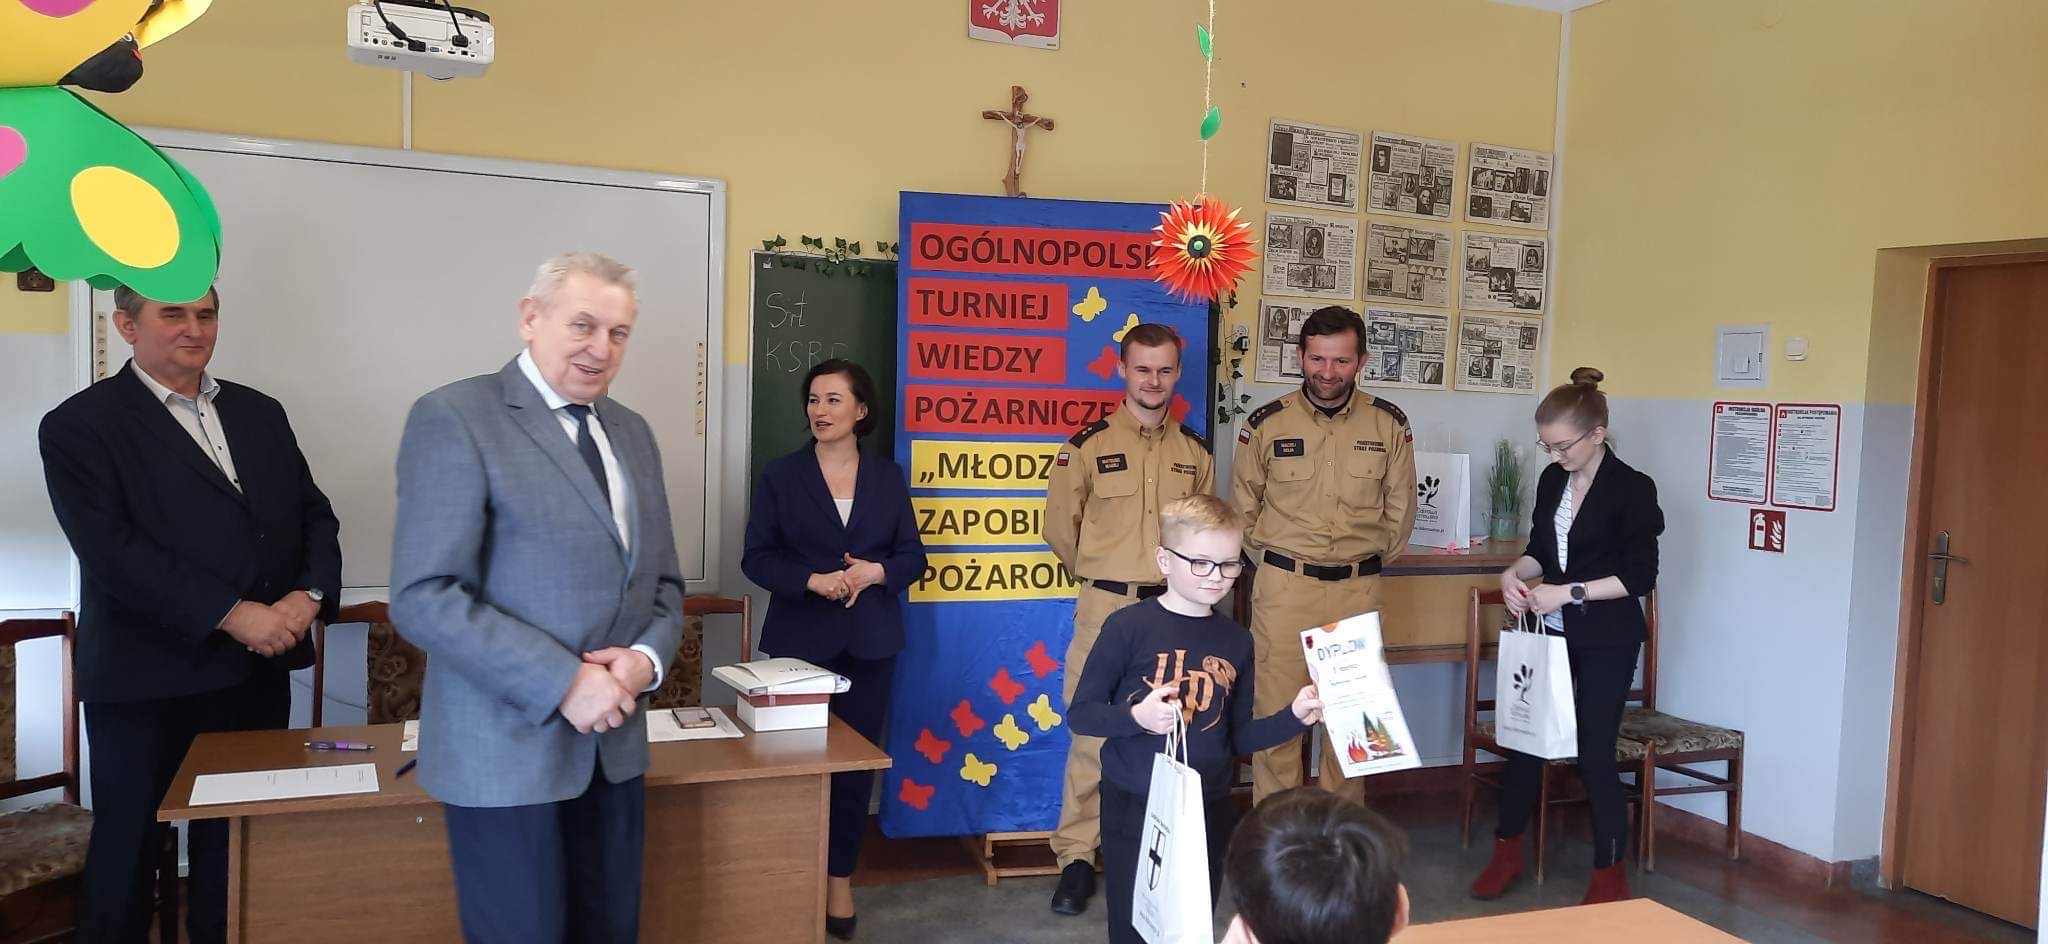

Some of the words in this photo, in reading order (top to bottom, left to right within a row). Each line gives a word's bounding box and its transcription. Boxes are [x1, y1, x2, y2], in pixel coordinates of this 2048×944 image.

[919, 231, 1161, 270] OGÓLNOPOLSK
[916, 289, 1049, 321] TURNIEJ
[917, 342, 1043, 373] WIEDZY
[915, 391, 1115, 427] POŻARNICZE
[919, 452, 1055, 484] „MŁODZ
[919, 508, 1045, 536] ZAPOBI
